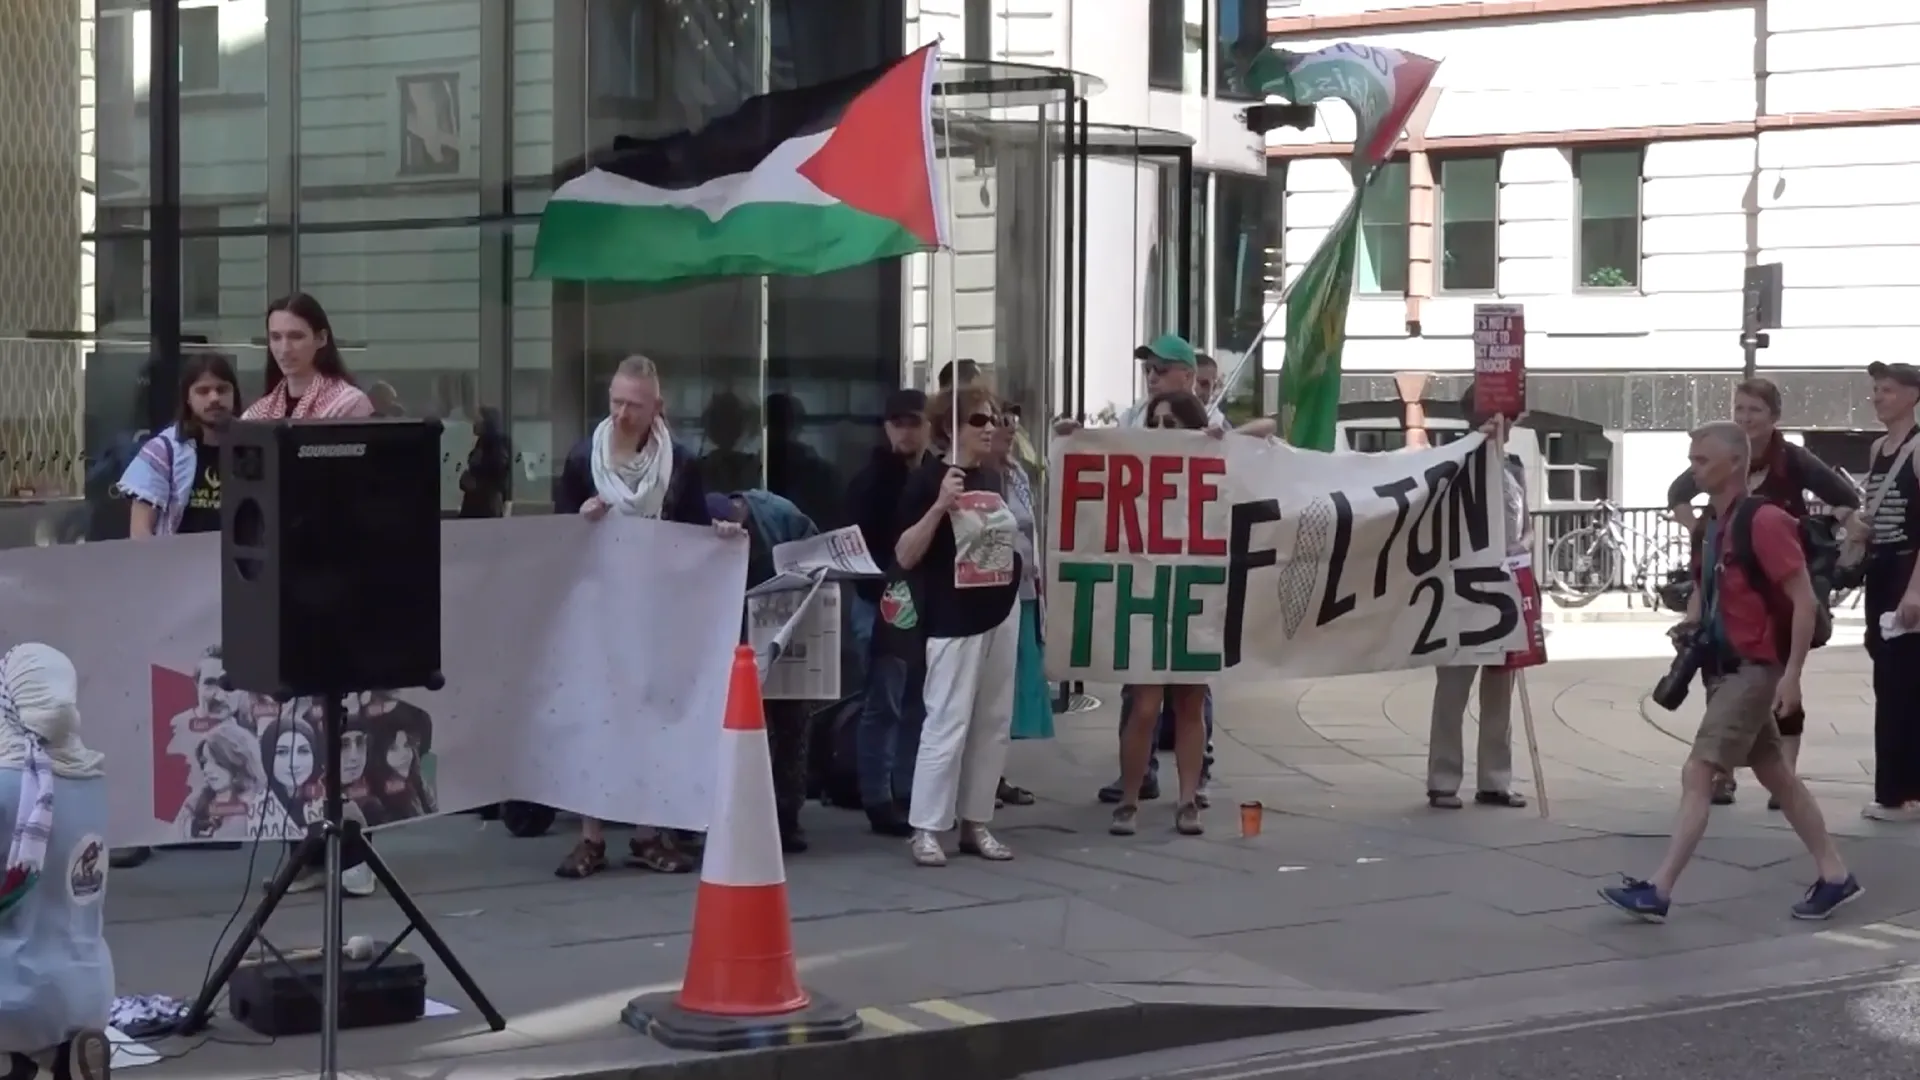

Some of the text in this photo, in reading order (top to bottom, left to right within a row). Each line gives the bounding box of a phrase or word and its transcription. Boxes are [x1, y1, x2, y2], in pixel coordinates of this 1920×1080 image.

[1500, 331, 1510, 344] TO
[1059, 453, 1227, 556] FREE
[1058, 562, 1227, 672] THE
[1408, 566, 1520, 655] 25
